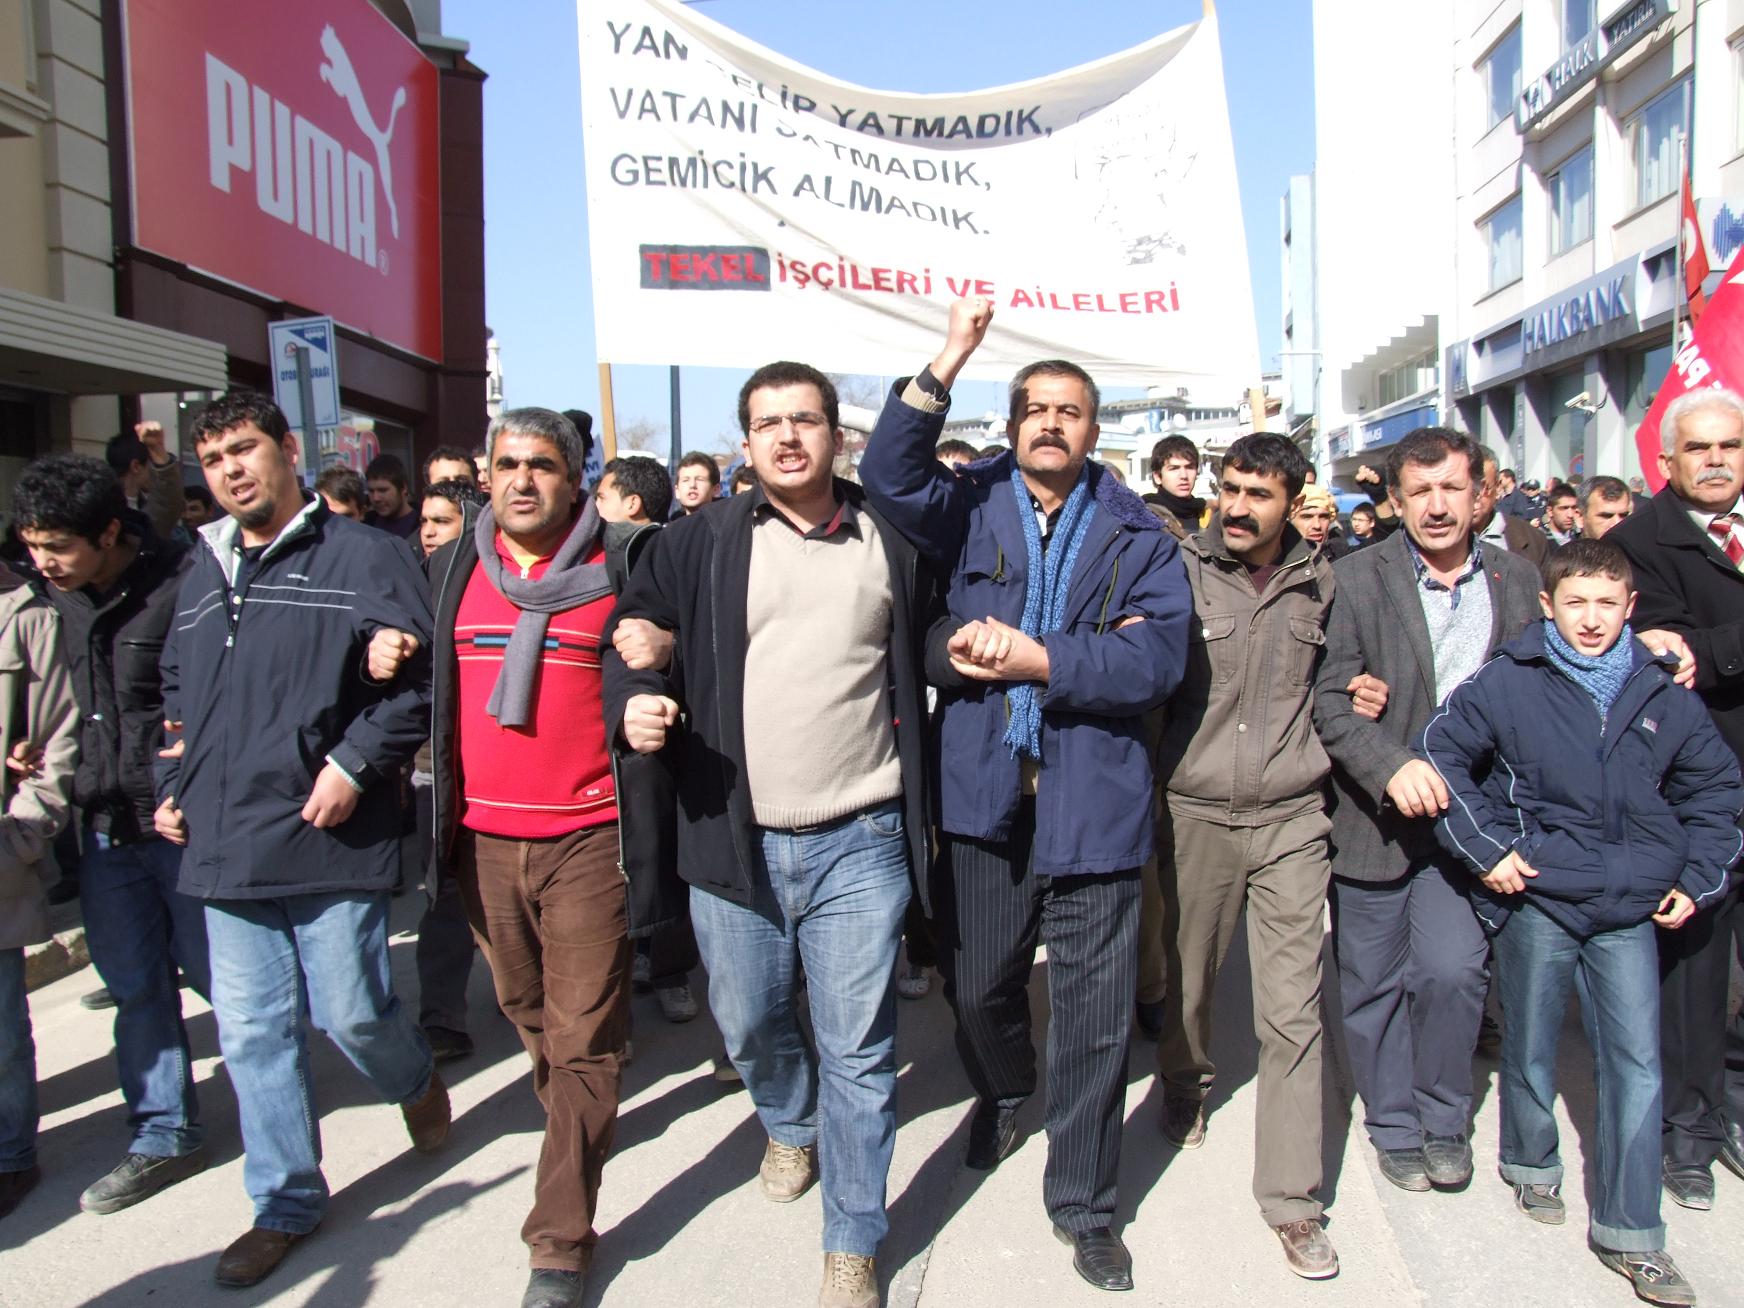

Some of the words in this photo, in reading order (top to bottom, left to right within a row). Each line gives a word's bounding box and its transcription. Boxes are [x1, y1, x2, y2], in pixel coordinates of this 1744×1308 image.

[606, 20, 688, 61] YAN
[831, 104, 1053, 138] YATMADIK,
[1554, 39, 1594, 91] HALK
[609, 86, 758, 134] VATANI
[205, 50, 377, 268] PUMA
[610, 149, 778, 195] GEMİCİK
[792, 173, 990, 235] ALMADIK.
[642, 251, 766, 283] TEKEL
[775, 252, 932, 296] İŞÇİLERİ
[944, 276, 995, 309] VE
[1009, 281, 1181, 314] AİLELERİ
[1520, 274, 1631, 354] HALKBANK
